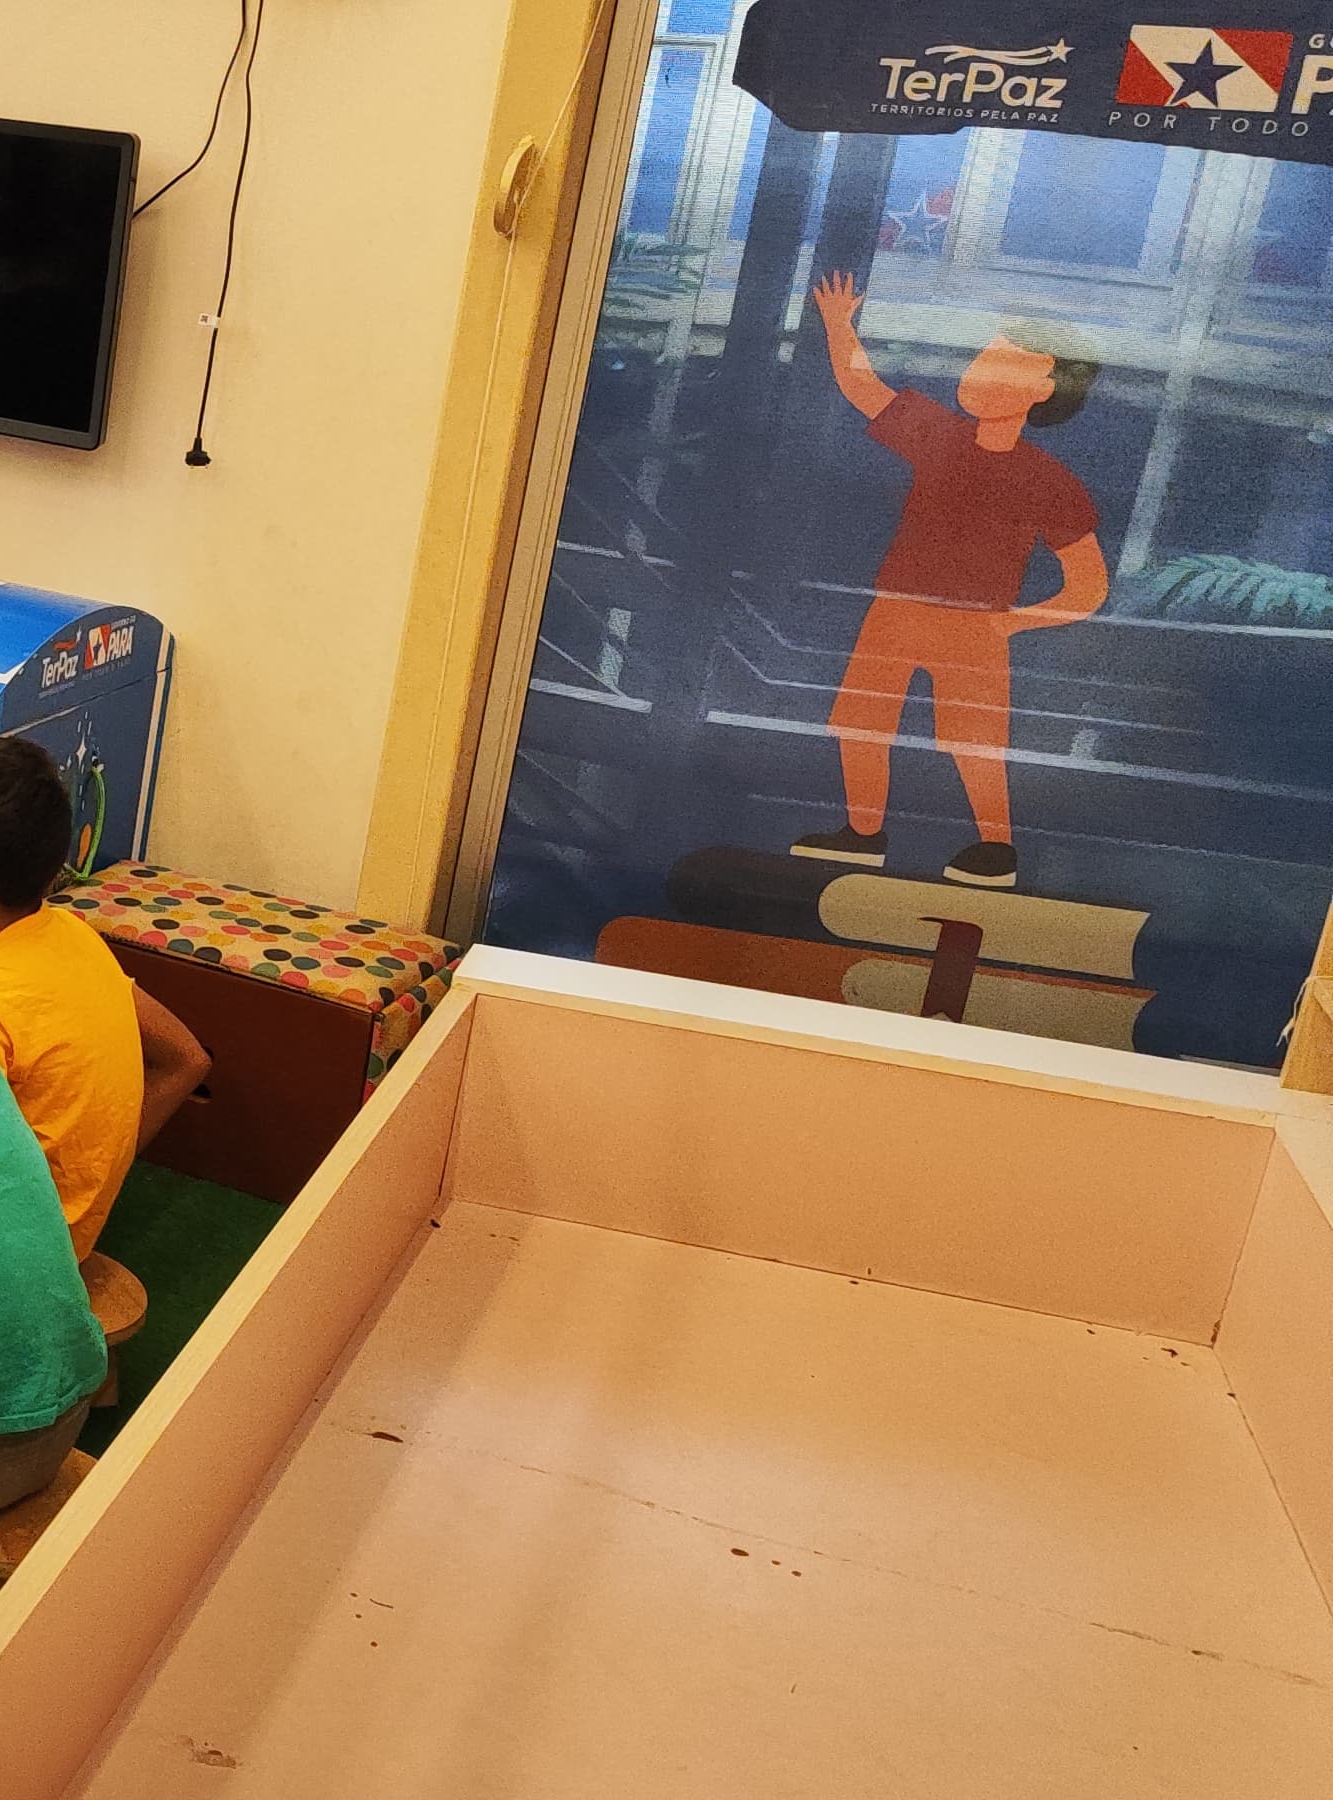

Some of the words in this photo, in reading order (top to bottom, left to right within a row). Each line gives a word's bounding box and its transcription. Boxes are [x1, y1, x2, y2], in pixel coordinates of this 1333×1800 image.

[879, 57, 1068, 109] TerPaz
[980, 109, 1020, 120] PELA
[1026, 112, 1060, 123] PAZ
[1108, 110, 1177, 129] POR
[1207, 115, 1309, 137] TODO
[41, 651, 79, 689] TerPaz
